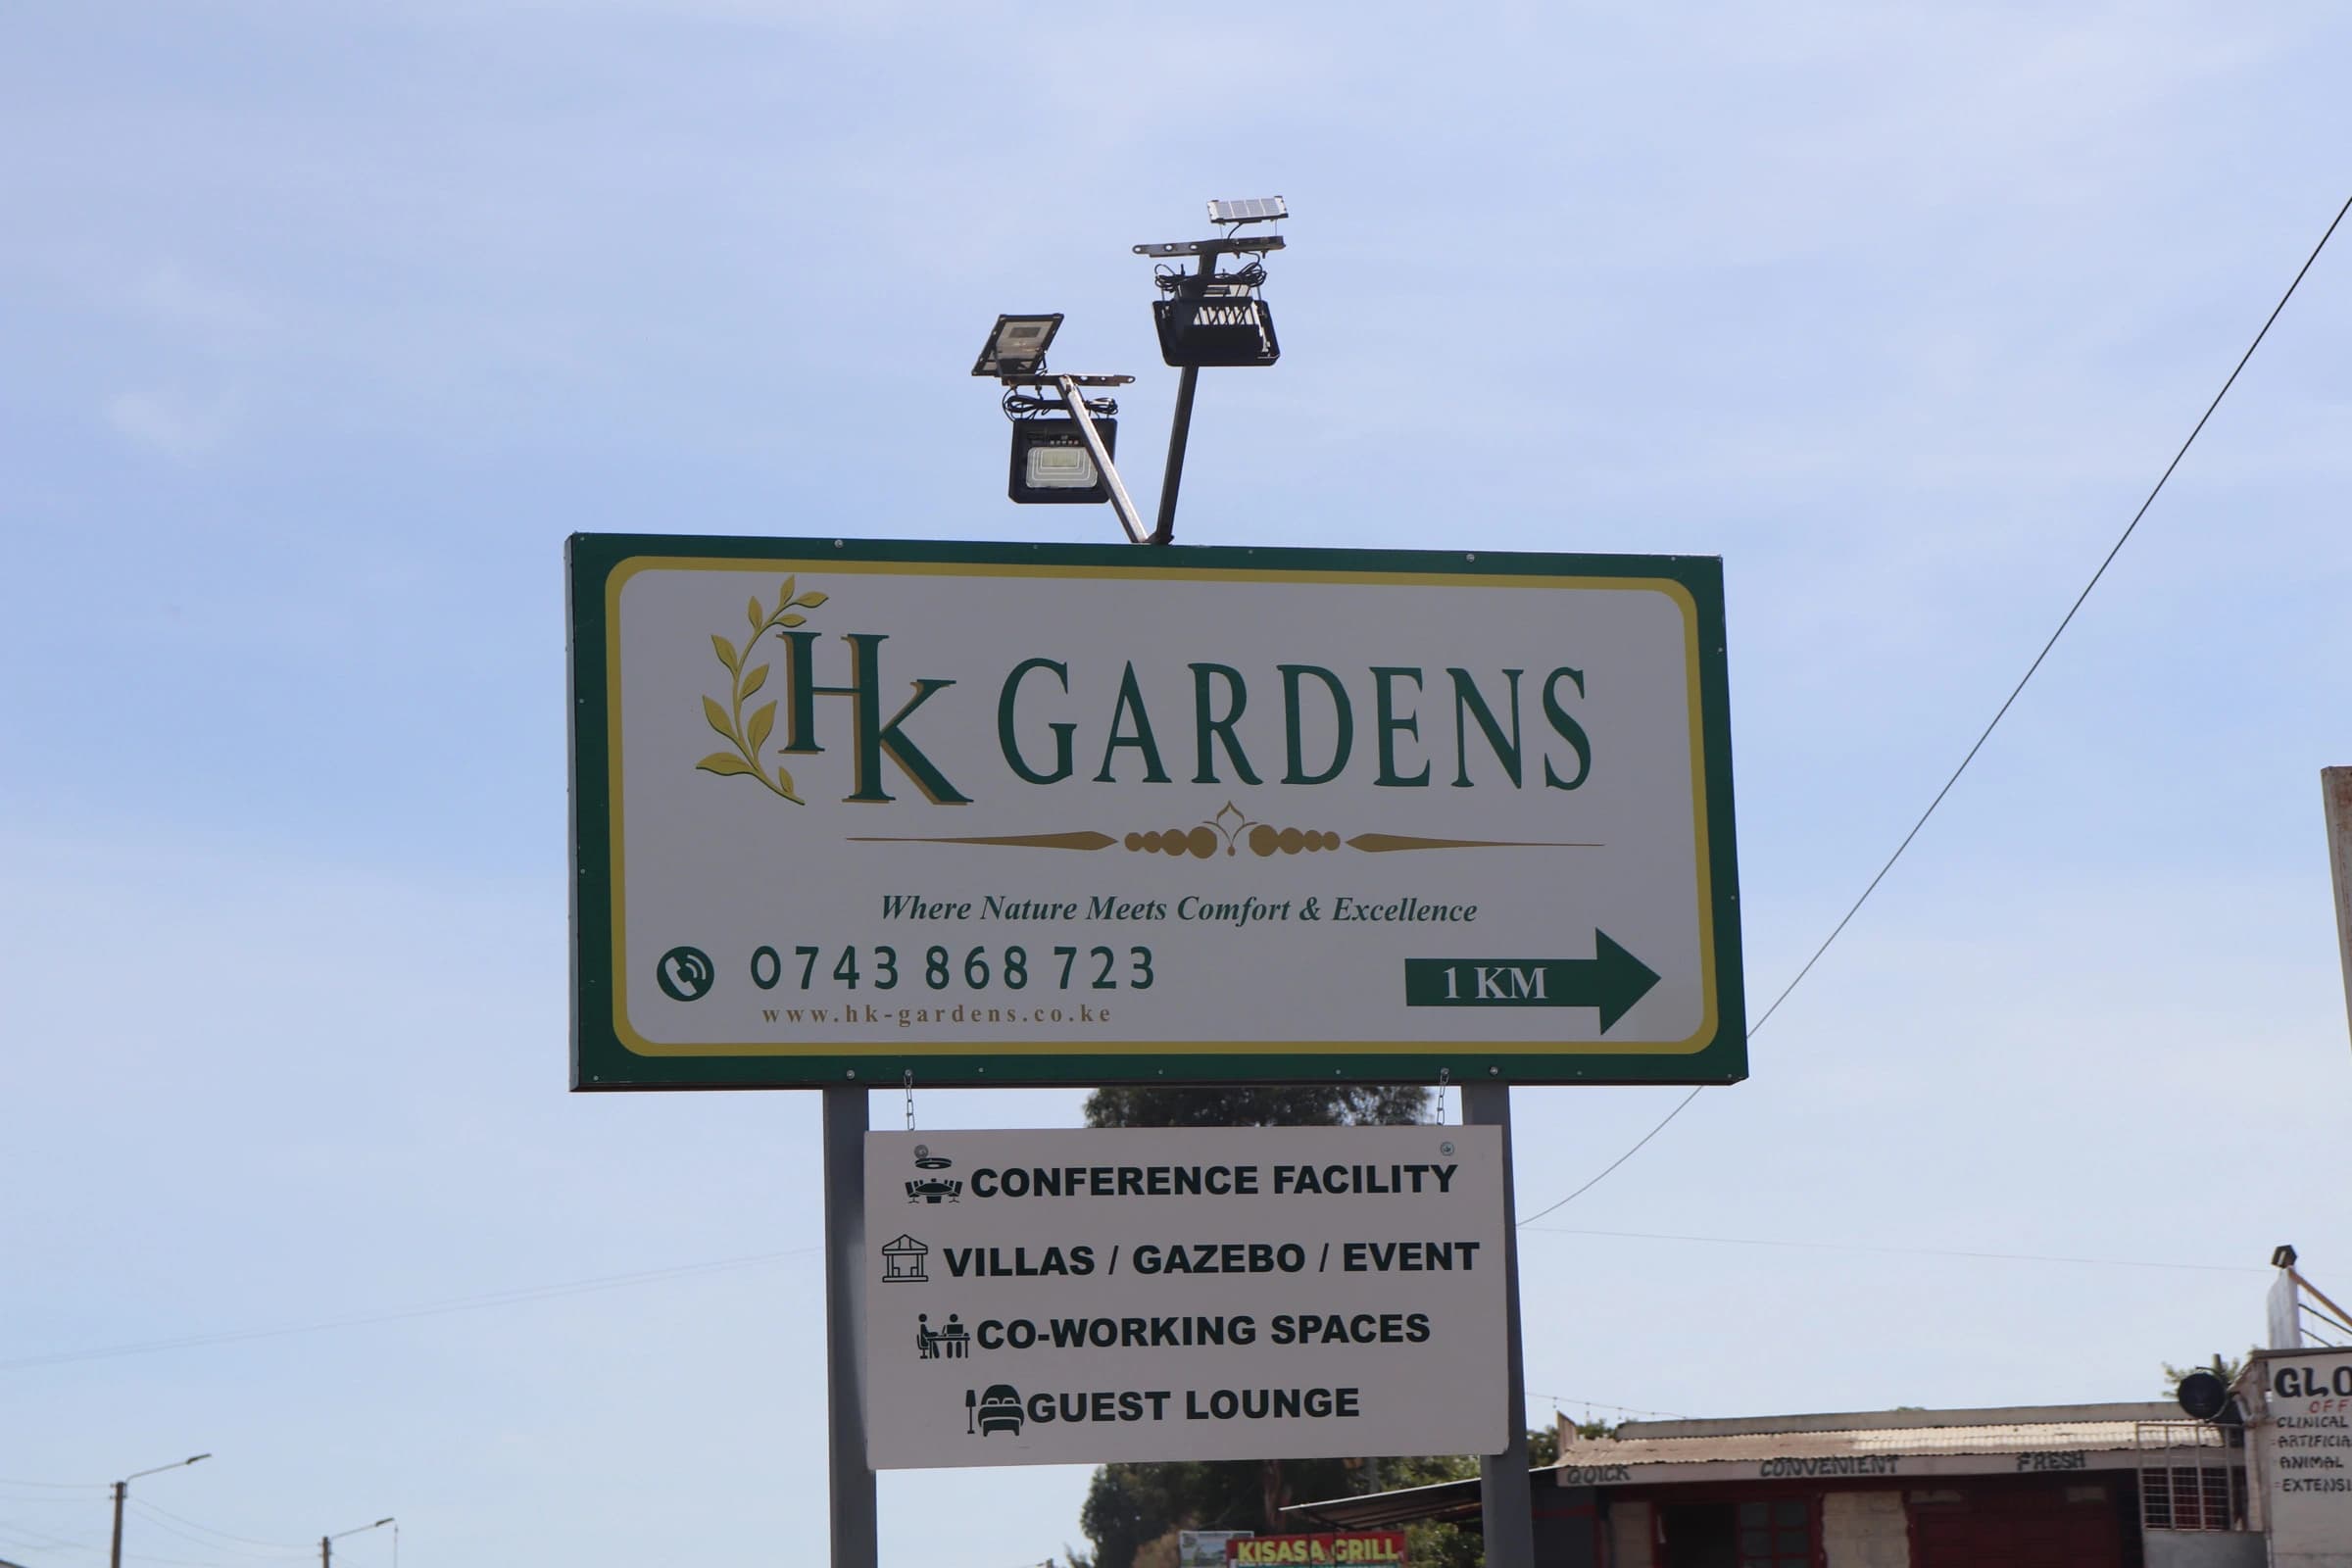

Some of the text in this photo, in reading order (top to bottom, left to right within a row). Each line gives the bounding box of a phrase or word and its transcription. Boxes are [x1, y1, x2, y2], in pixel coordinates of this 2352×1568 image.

[776, 630, 1592, 806] HK GARDENS
[882, 895, 1478, 927] Where Nature Meets Comfort & Excellence
[750, 945, 1154, 991] 0743 868 723
[1443, 966, 1549, 1000] 1 KM
[761, 1004, 1112, 1027] www.hk-gardens.co.ke
[970, 1164, 1458, 1199] CONFERENCE FACILITY
[943, 1242, 1481, 1278] VILLAS / GAZEBO / EVENT
[976, 1313, 1432, 1350] CO-WORKING SPACES
[2275, 1366, 2352, 1397] GLO
[1027, 1388, 1360, 1424] GUEST LOUNGE
[2277, 1416, 2349, 1428] CLINICAL
[1760, 1455, 1899, 1477] CONVENIENT
[2016, 1450, 2085, 1470] FRESH
[2279, 1456, 2344, 1469] ANIMAL
[1238, 1538, 1399, 1563] KISASA GRILL
